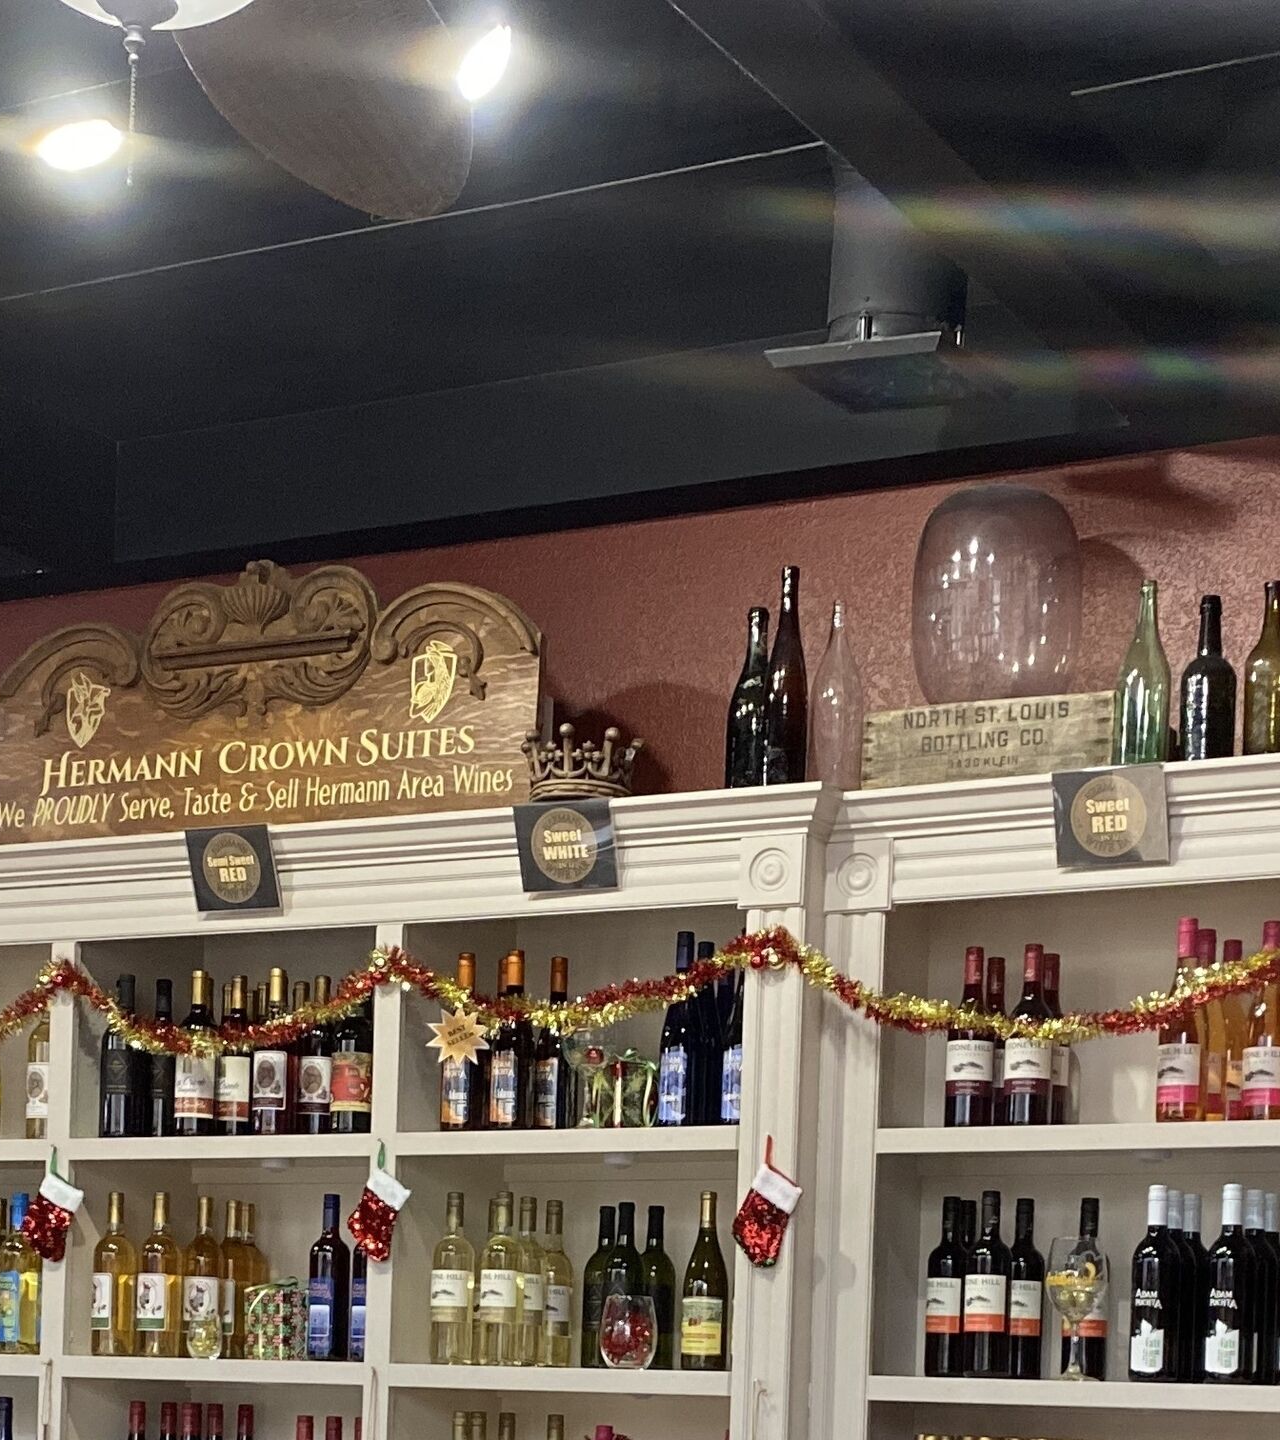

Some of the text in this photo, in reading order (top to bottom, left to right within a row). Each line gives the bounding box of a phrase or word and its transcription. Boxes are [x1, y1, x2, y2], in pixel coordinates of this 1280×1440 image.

[903, 701, 1070, 730] NORTH ST. LOUIS
[920, 728, 1048, 753] BOTTLING CO.
[41, 724, 476, 796] HERMANN CROWN SUITES
[32, 790, 114, 826] PROUDLY
[119, 787, 175, 822] Serve,
[183, 785, 231, 816] Taste
[238, 782, 258, 812] &
[264, 779, 299, 811] Sell
[304, 772, 390, 807] Hermann
[396, 768, 445, 800] Area
[452, 764, 513, 795] Wines
[1086, 798, 1129, 814] Sweet
[1091, 814, 1128, 833] RED
[543, 829, 582, 843] Sweet
[543, 844, 589, 860] WHITE
[219, 867, 247, 882] RED
